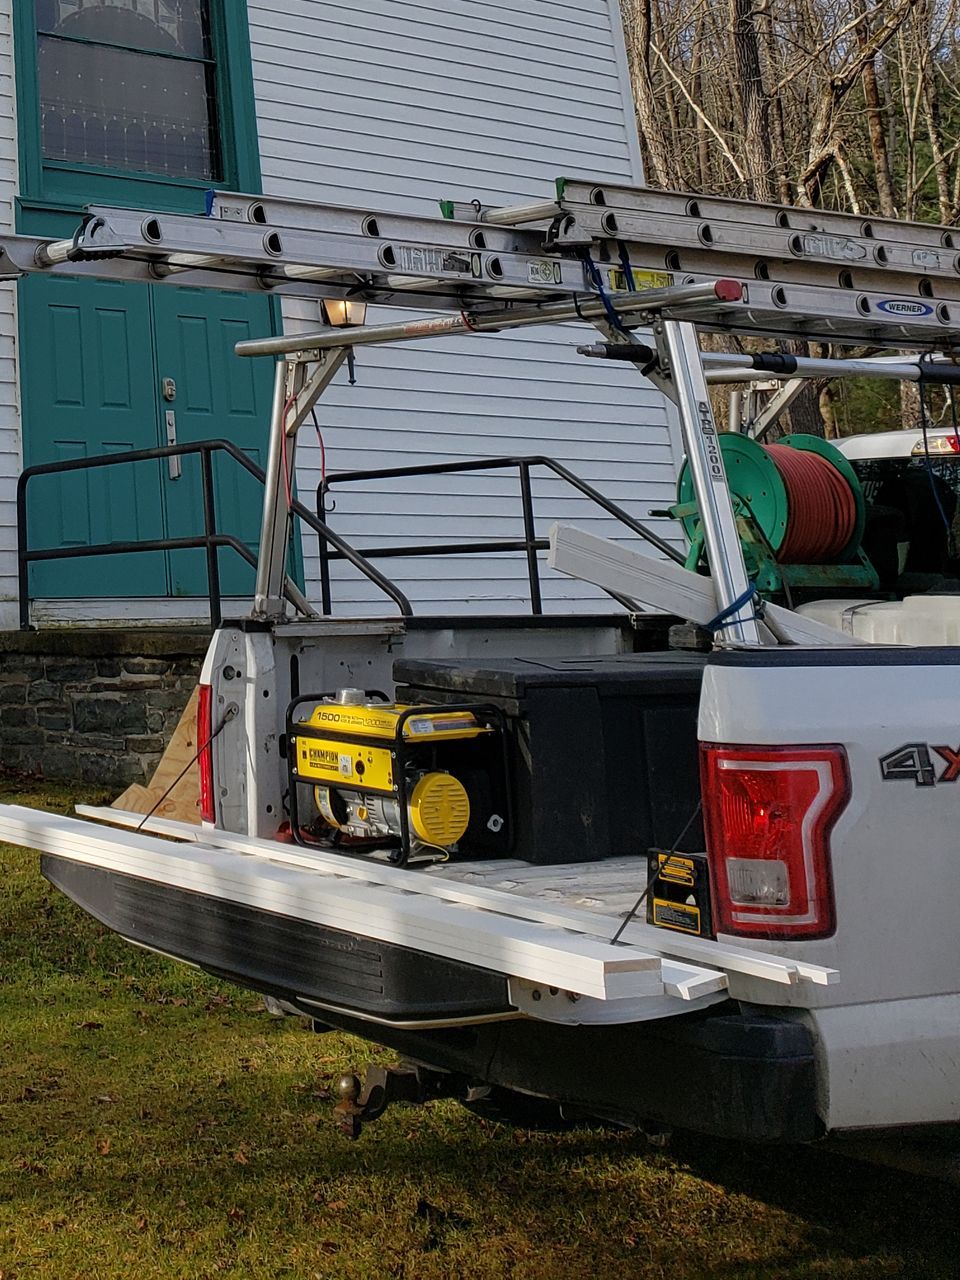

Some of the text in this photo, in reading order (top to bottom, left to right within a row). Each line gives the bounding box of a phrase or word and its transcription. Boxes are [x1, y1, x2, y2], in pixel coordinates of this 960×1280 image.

[888, 302, 923, 313] WERNER
[317, 711, 341, 723] 1500
[309, 748, 339, 763] CHAMPION
